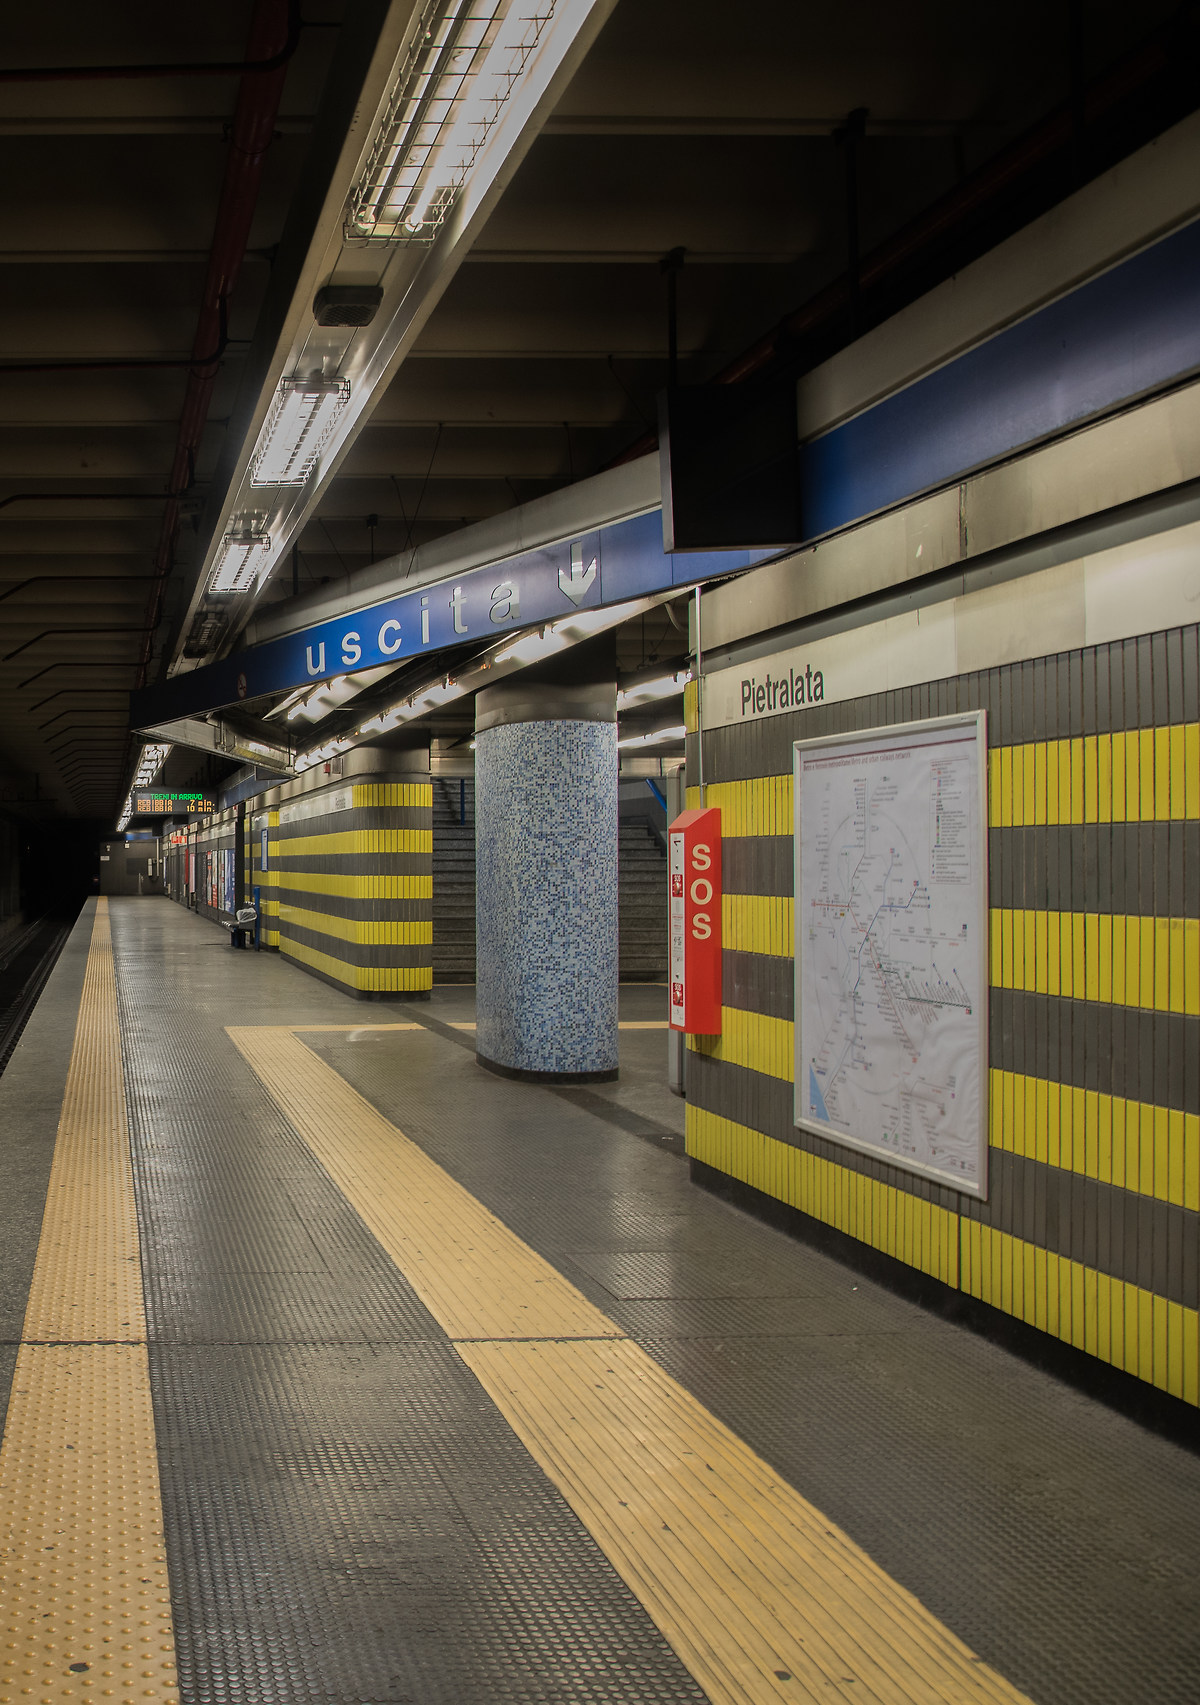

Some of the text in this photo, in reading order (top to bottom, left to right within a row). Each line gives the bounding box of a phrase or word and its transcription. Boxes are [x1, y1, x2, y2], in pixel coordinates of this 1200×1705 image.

[306, 581, 521, 676] uscita
[741, 664, 824, 716] Pietralata
[690, 844, 713, 940] SOS
